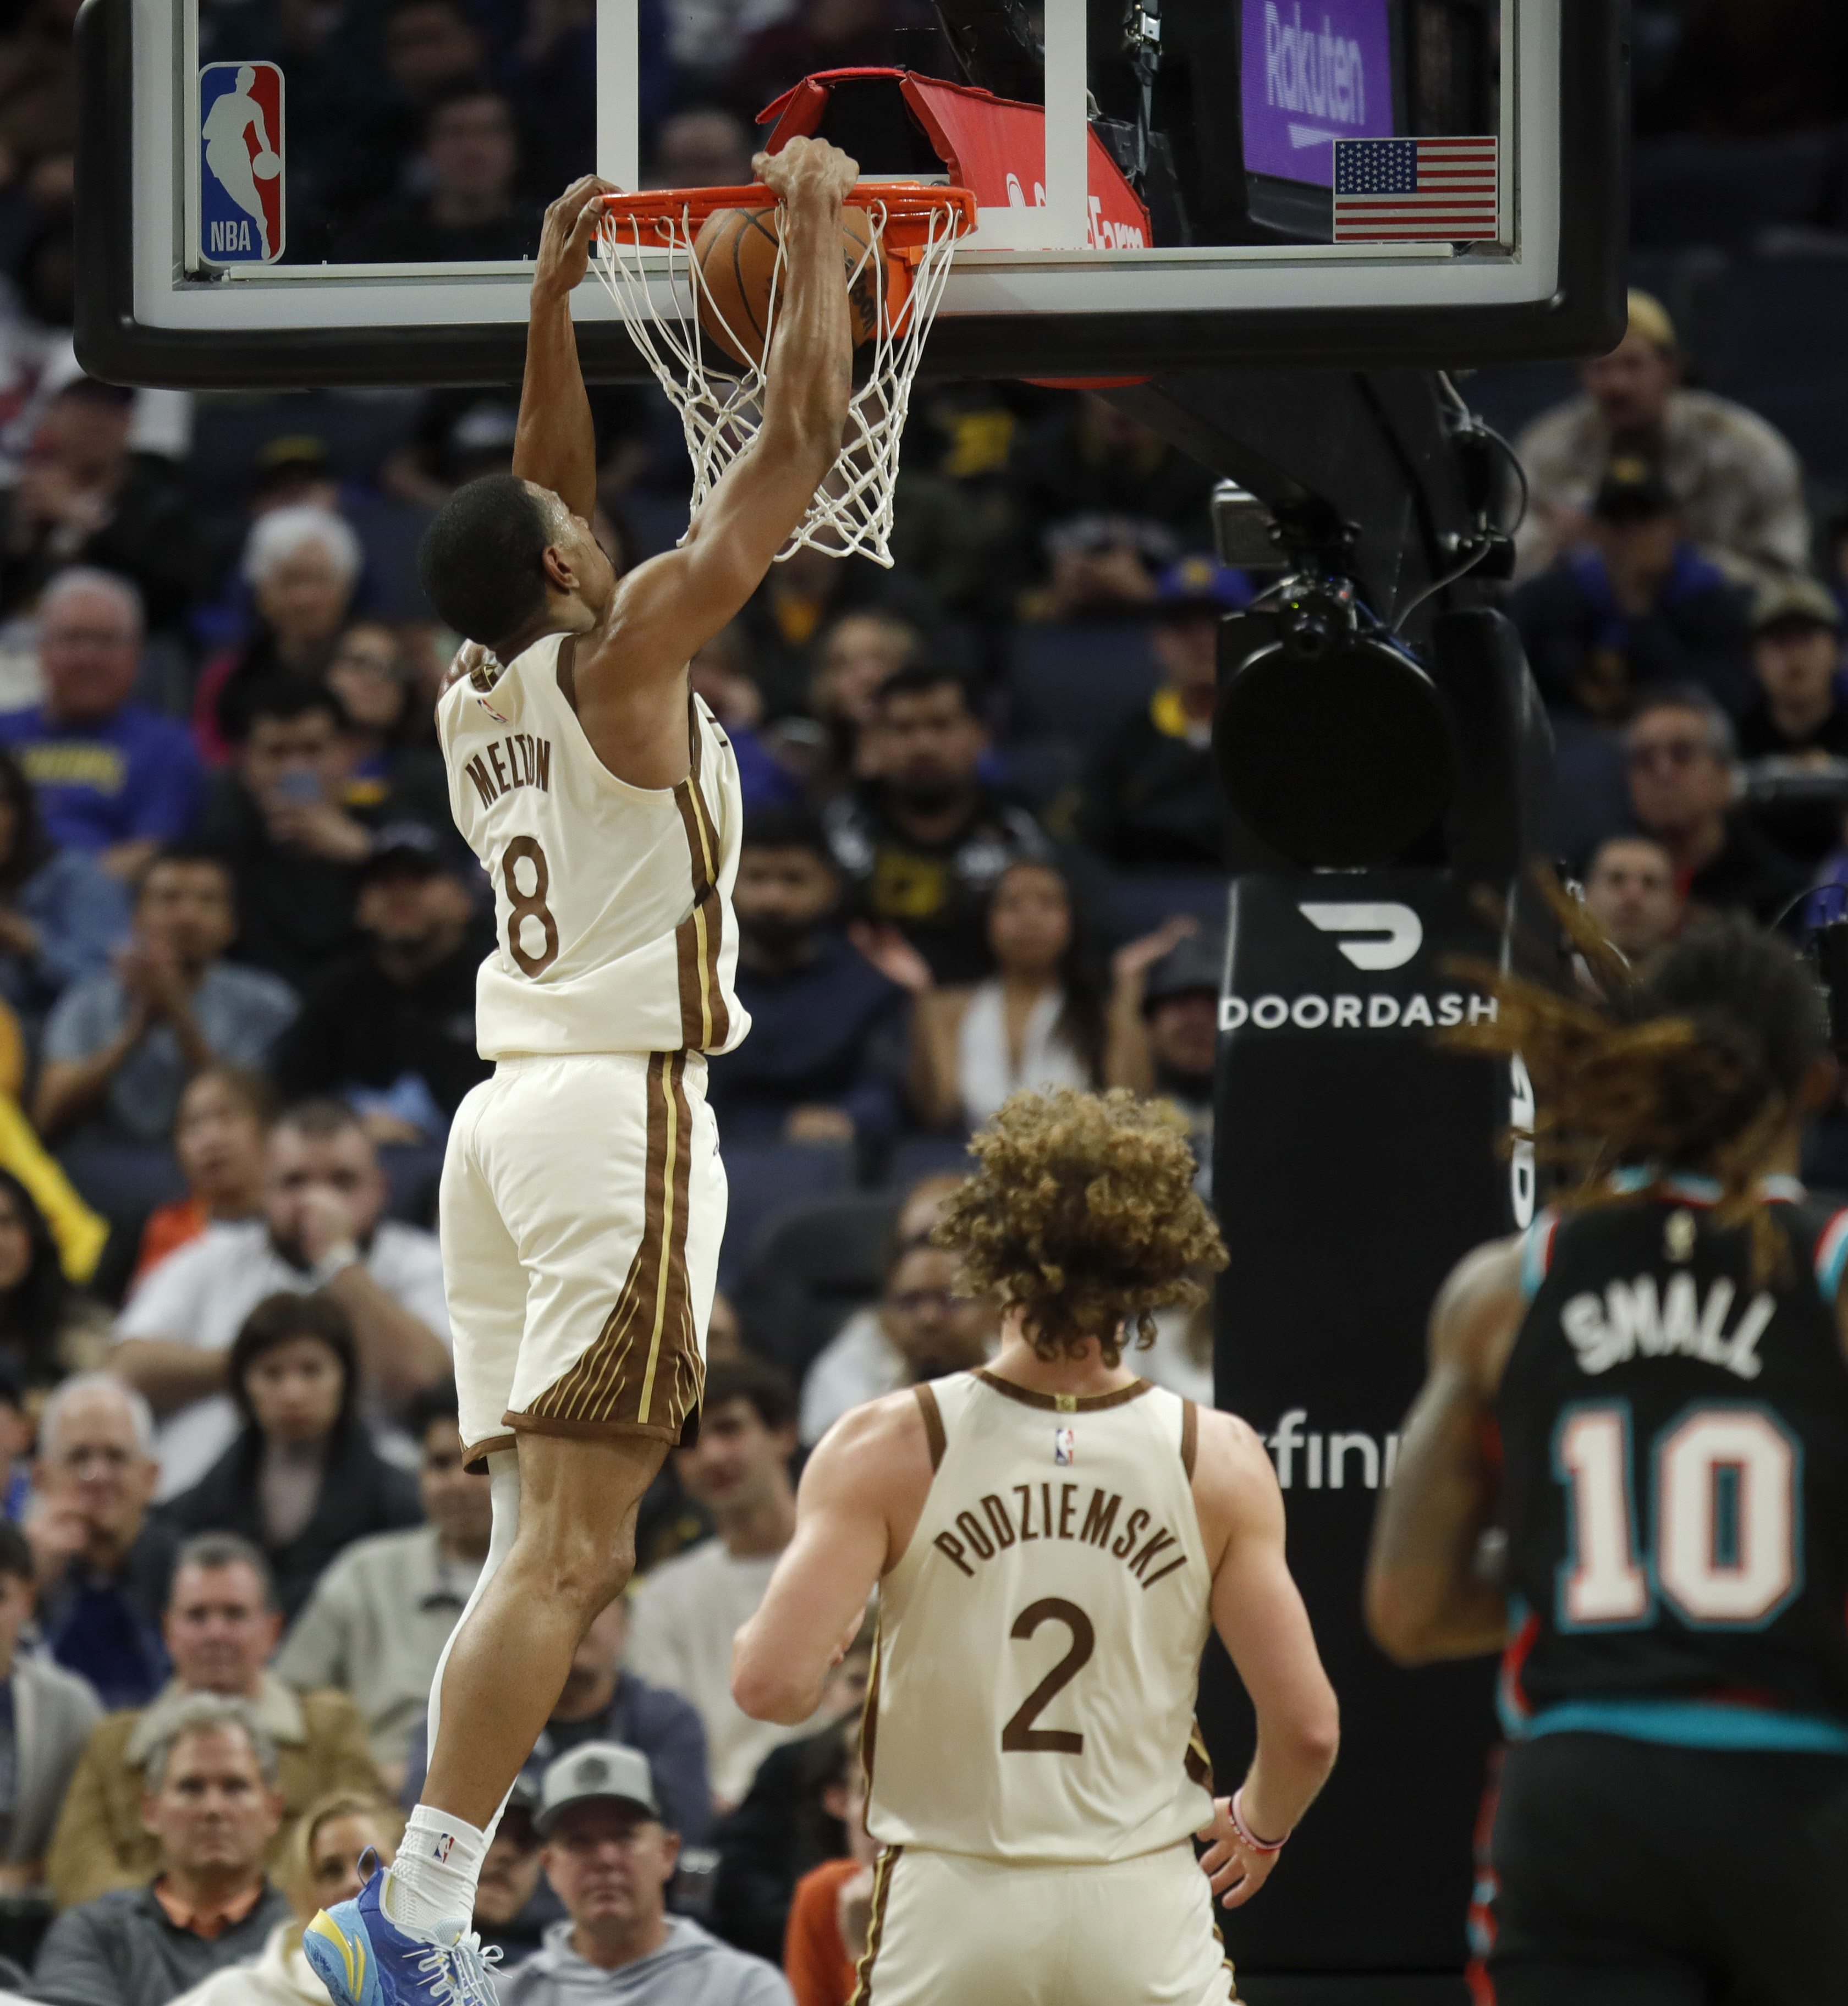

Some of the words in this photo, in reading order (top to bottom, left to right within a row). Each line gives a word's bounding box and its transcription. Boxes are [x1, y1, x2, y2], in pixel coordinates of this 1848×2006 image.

[1266, 1, 1365, 125] Rakuten
[211, 221, 251, 251] NBA
[465, 734, 551, 811] MELTON
[502, 836, 558, 978] 8
[1218, 993, 1499, 1032] DOORDASH
[1560, 1271, 1778, 1381] SMALL
[934, 1483, 1187, 1590] PODZIEMSKI
[1550, 1397, 1807, 1633] 10
[1002, 1597, 1096, 1755] 2
